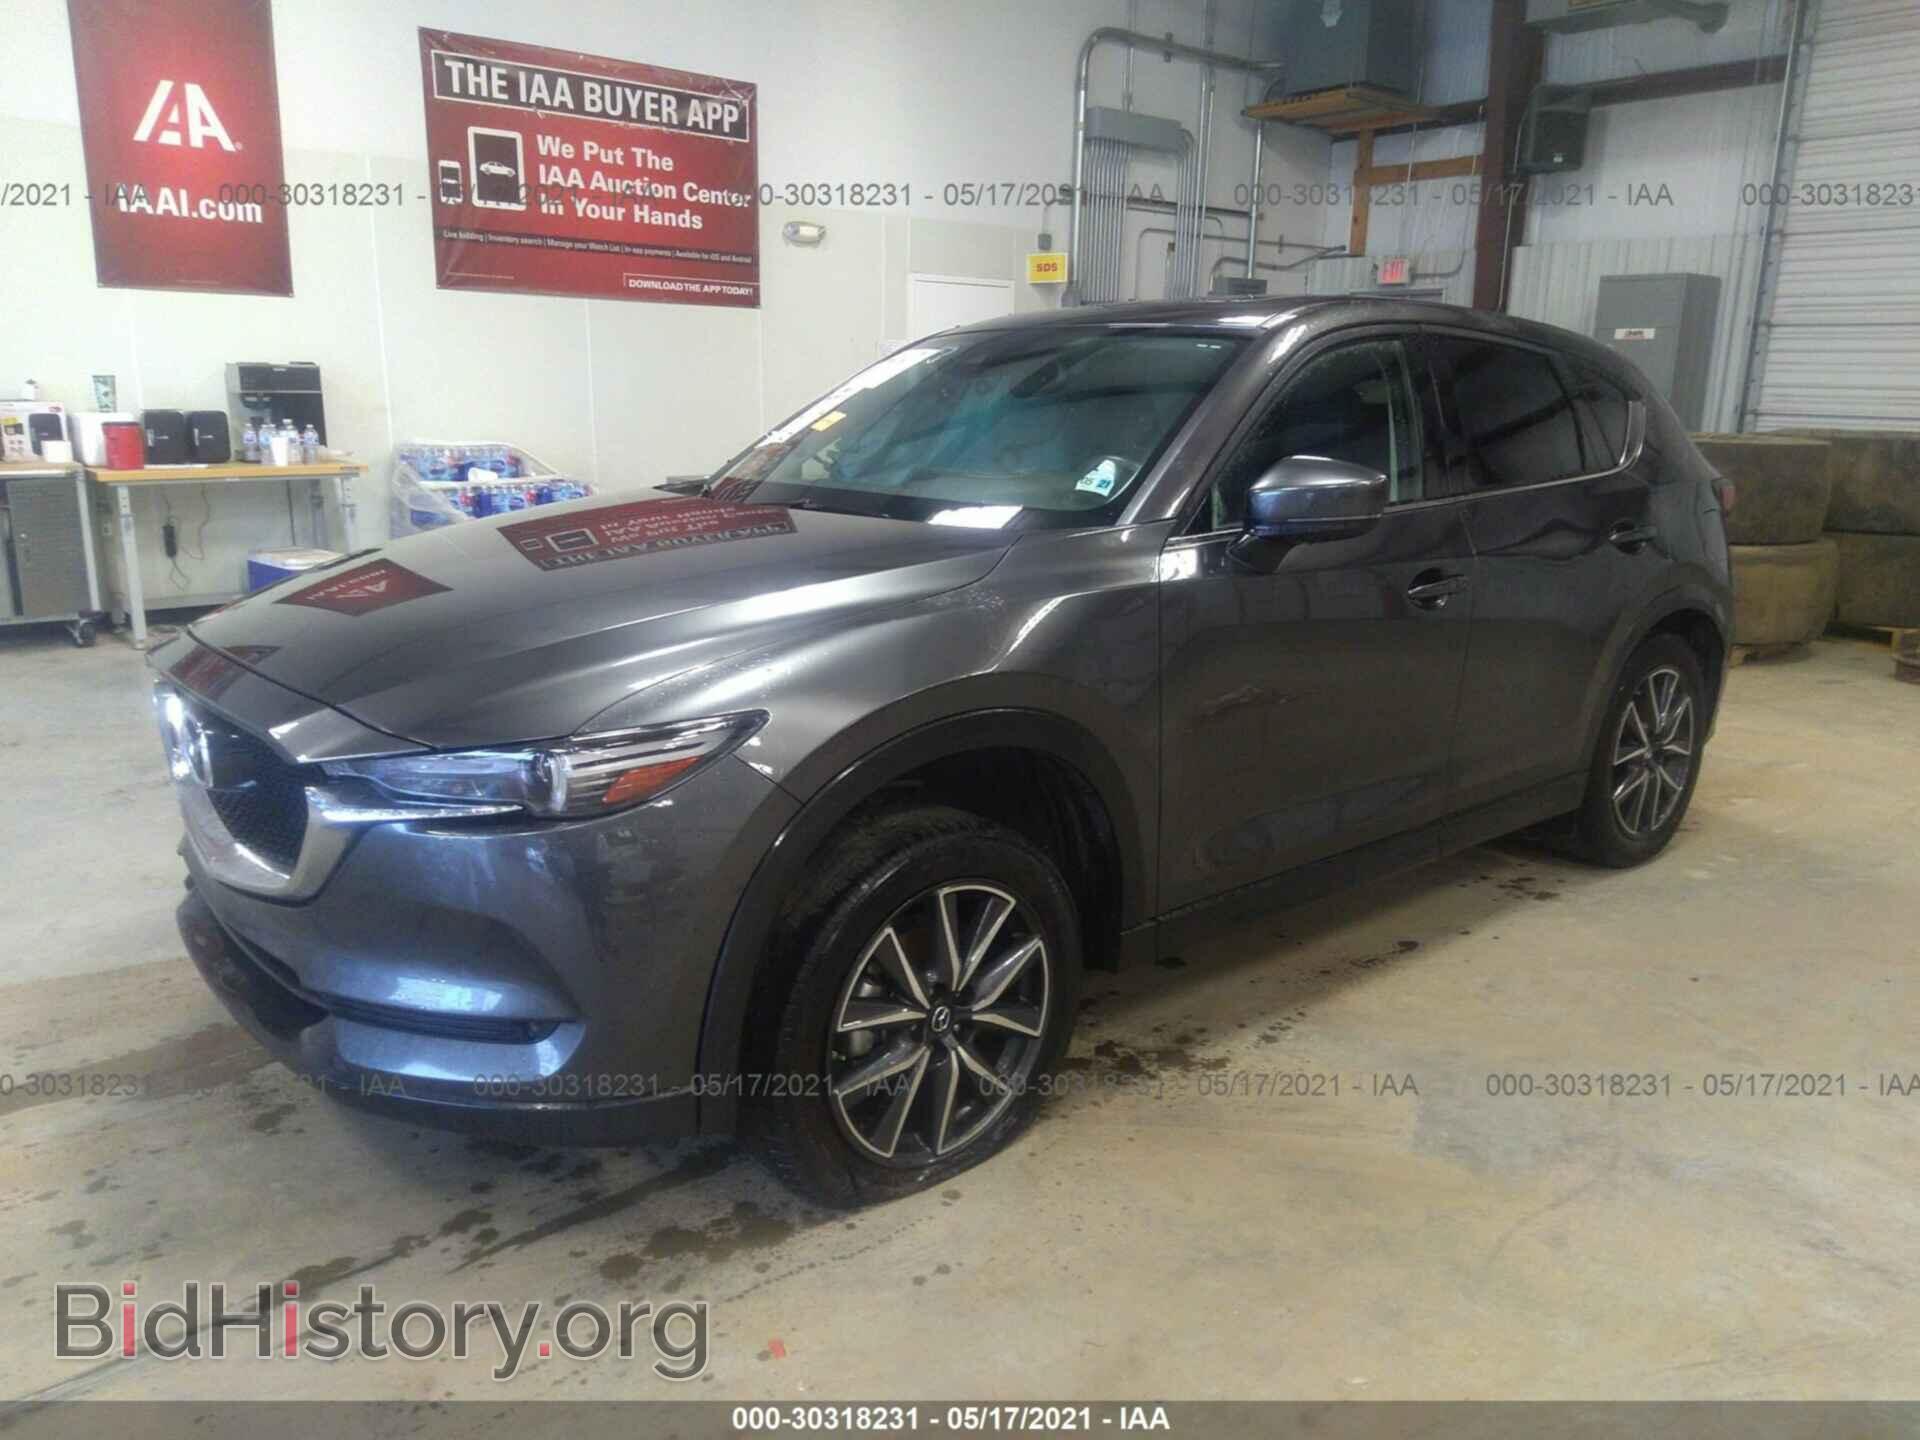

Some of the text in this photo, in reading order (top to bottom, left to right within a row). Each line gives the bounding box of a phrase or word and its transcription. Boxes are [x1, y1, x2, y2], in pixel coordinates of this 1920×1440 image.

[444, 59, 739, 133] THE IAA BUYER APP
[536, 134, 673, 171] We Put The
[539, 164, 751, 208] IAA Auction Center
[540, 192, 703, 230] In Your Hands
[629, 278, 684, 291] DOWNLOAD
[685, 283, 701, 292] THE
[703, 284, 721, 294] APP
[1036, 262, 1058, 273] SDS
